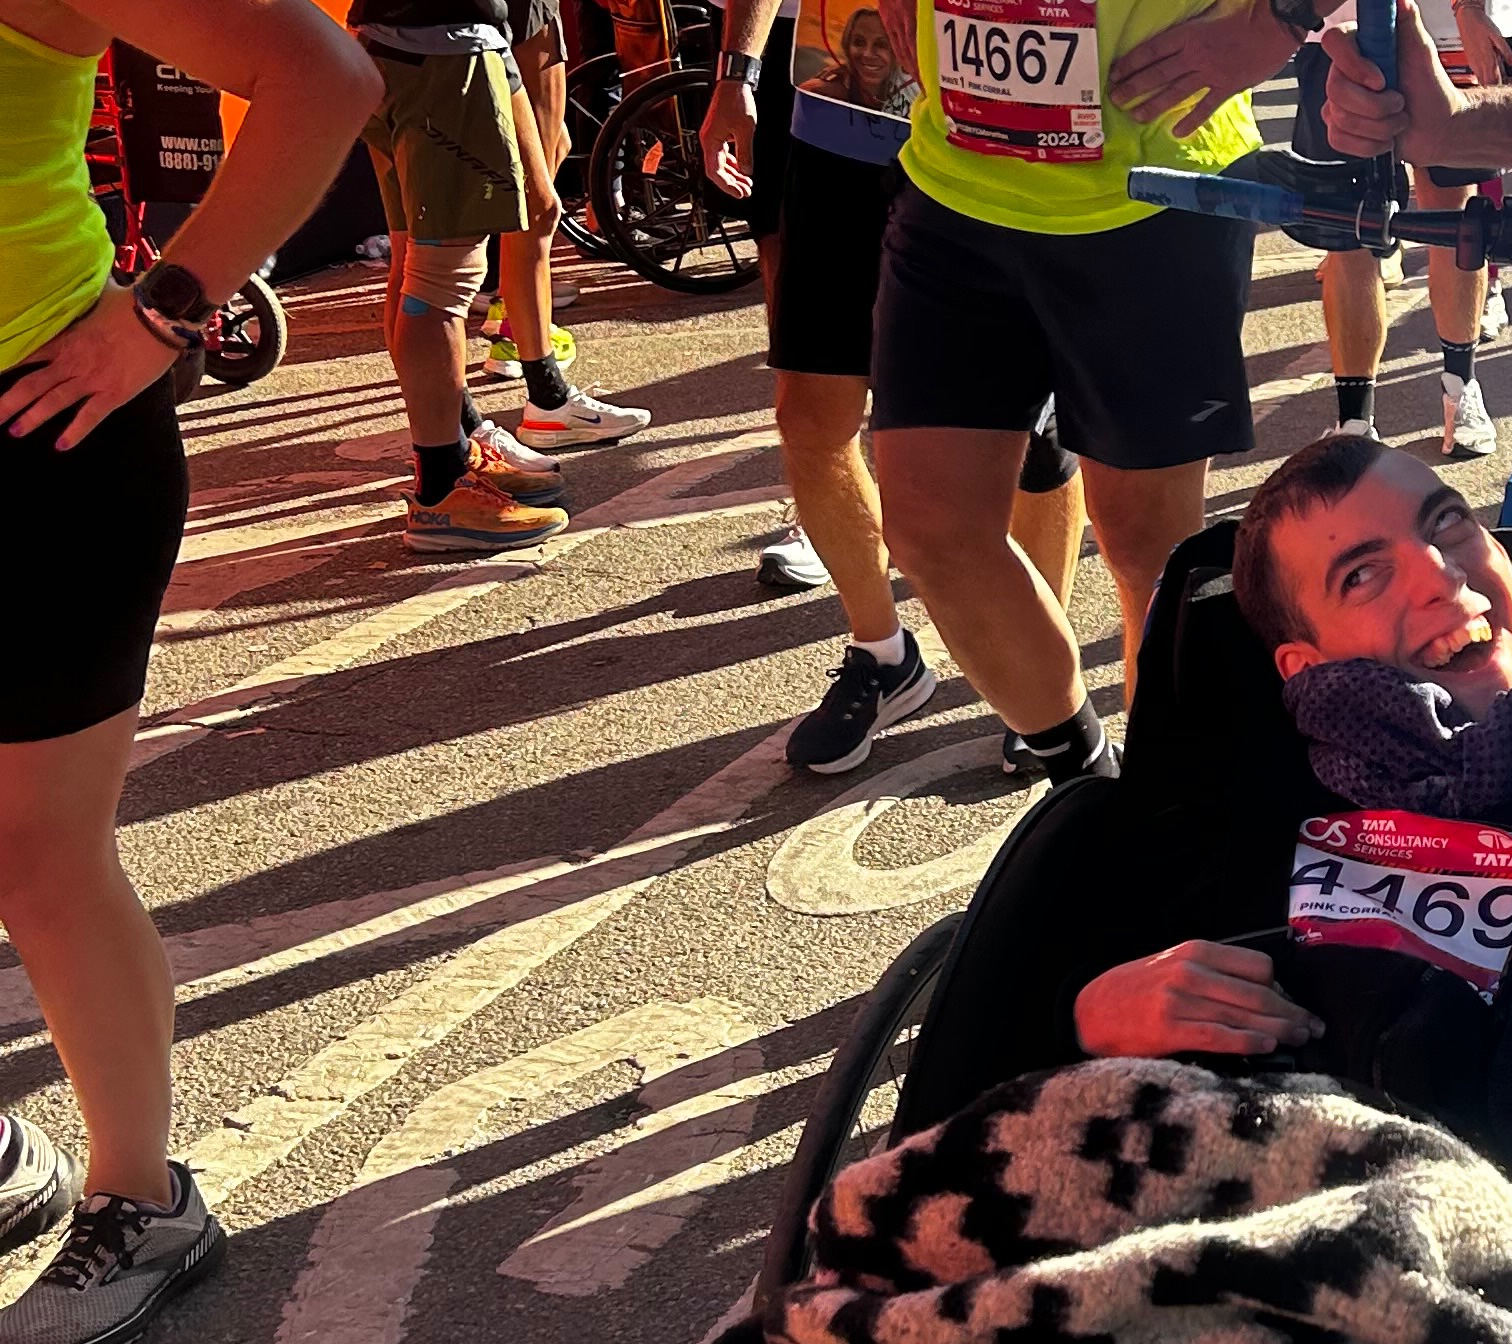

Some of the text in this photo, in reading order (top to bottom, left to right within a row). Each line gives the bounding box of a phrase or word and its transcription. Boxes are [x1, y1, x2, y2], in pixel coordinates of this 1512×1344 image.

[1039, 7, 1070, 18] TATA
[944, 19, 1079, 86] 14667
[960, 76, 965, 89] 1
[1037, 133, 1080, 147] 2024
[410, 510, 449, 526] HOKA
[1362, 819, 1396, 832] TATA
[1357, 832, 1449, 849] CONSULTANCY
[1352, 843, 1413, 859] SERVICES
[1300, 902, 1336, 912] PINK
